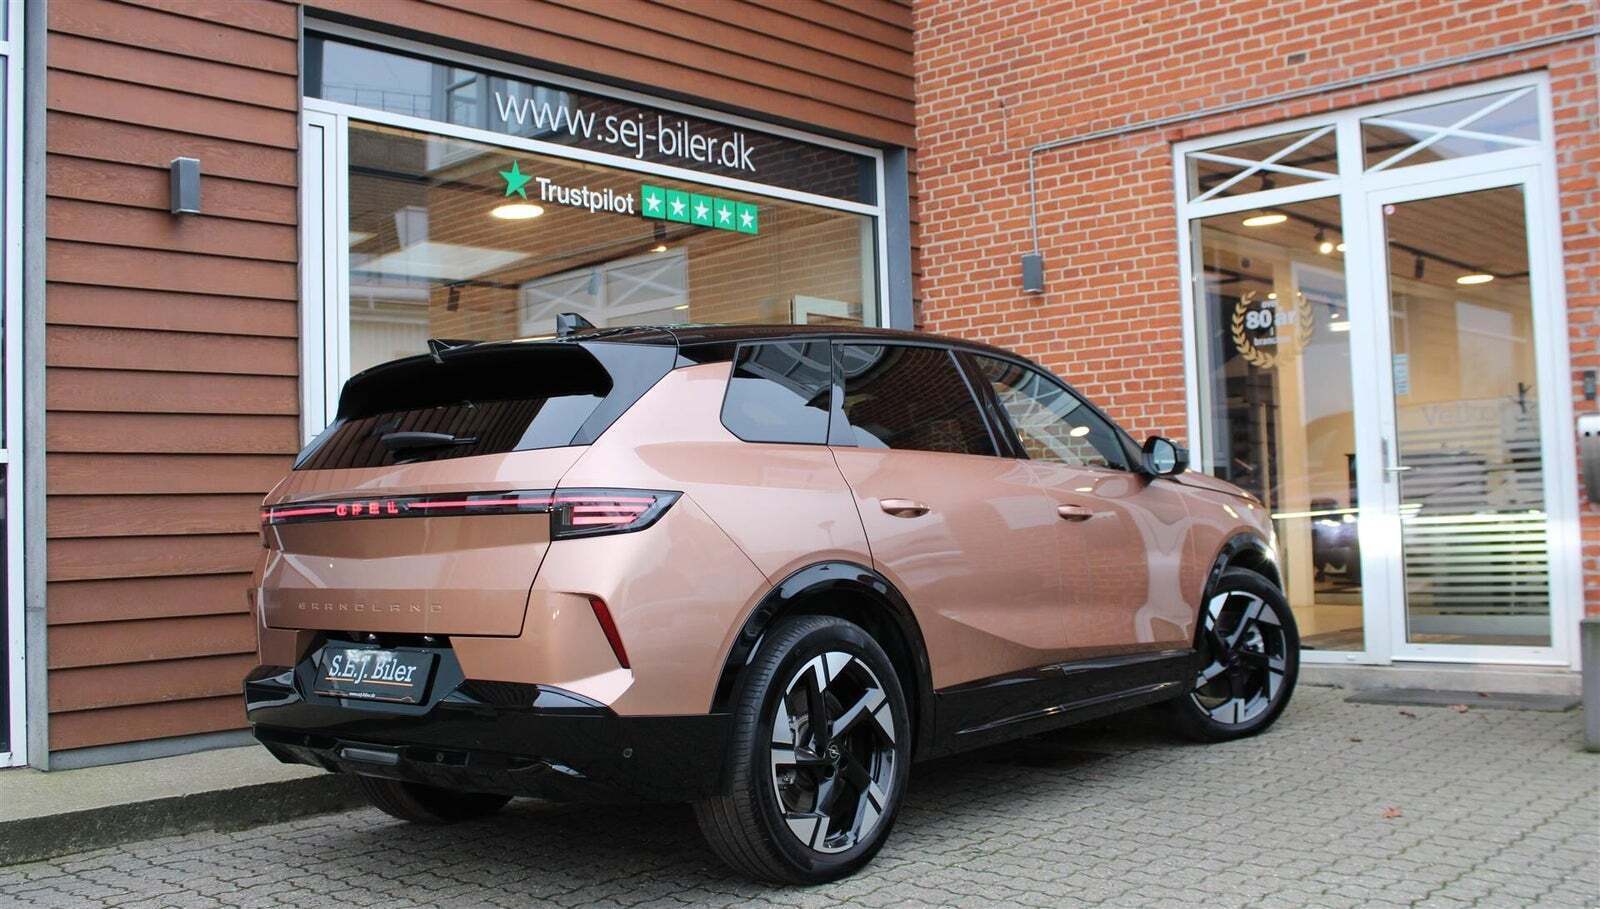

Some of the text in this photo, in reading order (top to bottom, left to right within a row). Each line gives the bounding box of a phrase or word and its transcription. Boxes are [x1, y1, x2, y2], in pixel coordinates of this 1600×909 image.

[495, 92, 756, 172] www.sej-biler.dk
[535, 176, 634, 215] Trustpilot
[1245, 309, 1272, 330] 80
[336, 501, 399, 516] OPEL
[329, 654, 417, 684] S.E.J. Biler
